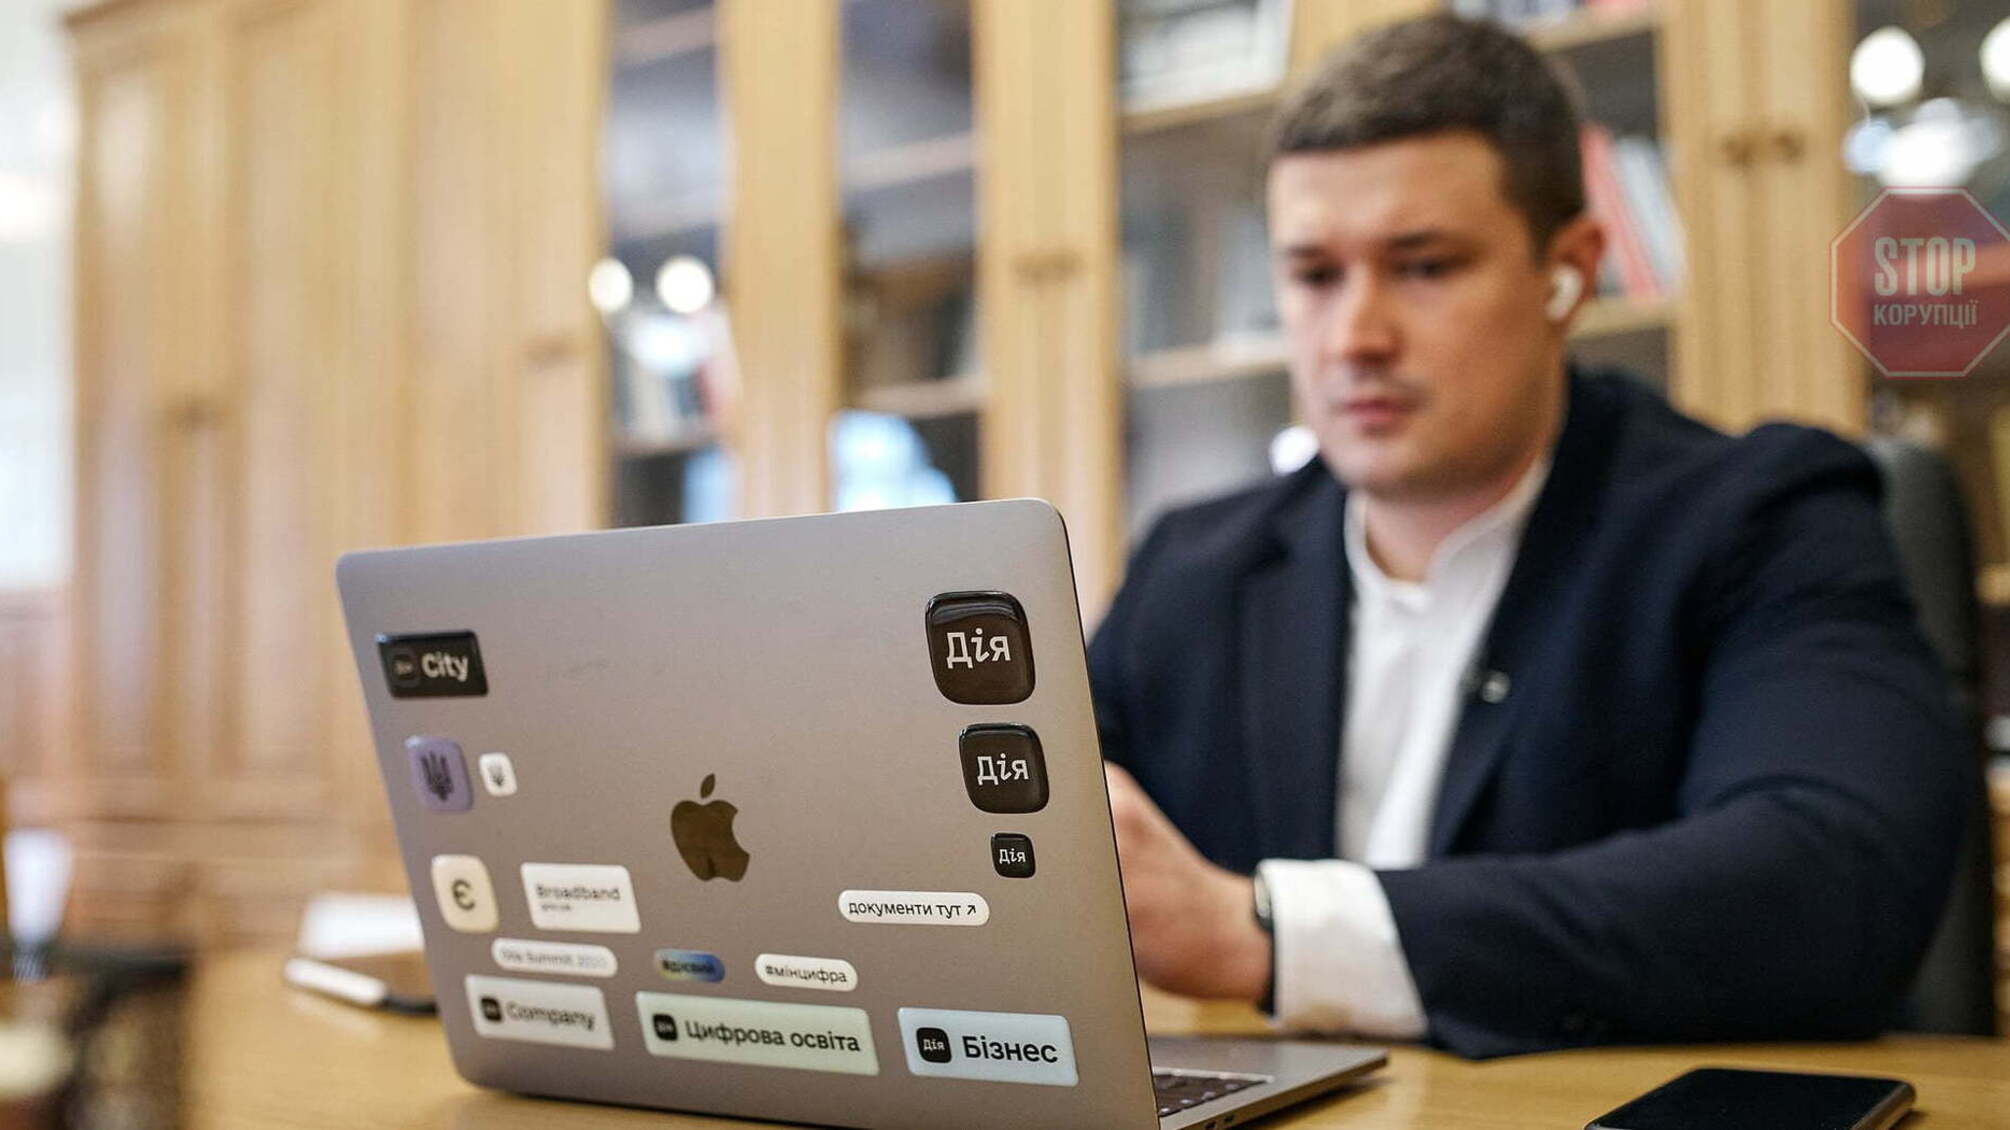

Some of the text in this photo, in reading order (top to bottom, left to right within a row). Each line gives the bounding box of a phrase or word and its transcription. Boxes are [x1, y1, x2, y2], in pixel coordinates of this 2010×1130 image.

[946, 627, 1012, 669] Дія
[420, 650, 469, 682] City
[976, 752, 1030, 786] Дія
[999, 847, 1026, 865] Дія
[535, 883, 621, 901] Broadband
[848, 901, 961, 919] документи тут
[764, 962, 848, 984] #мінцифра
[506, 1001, 595, 1031] Company
[684, 1020, 785, 1046] Цифрова
[790, 1031, 861, 1052] освіта
[922, 1035, 1059, 1063] Дія Бізнес
